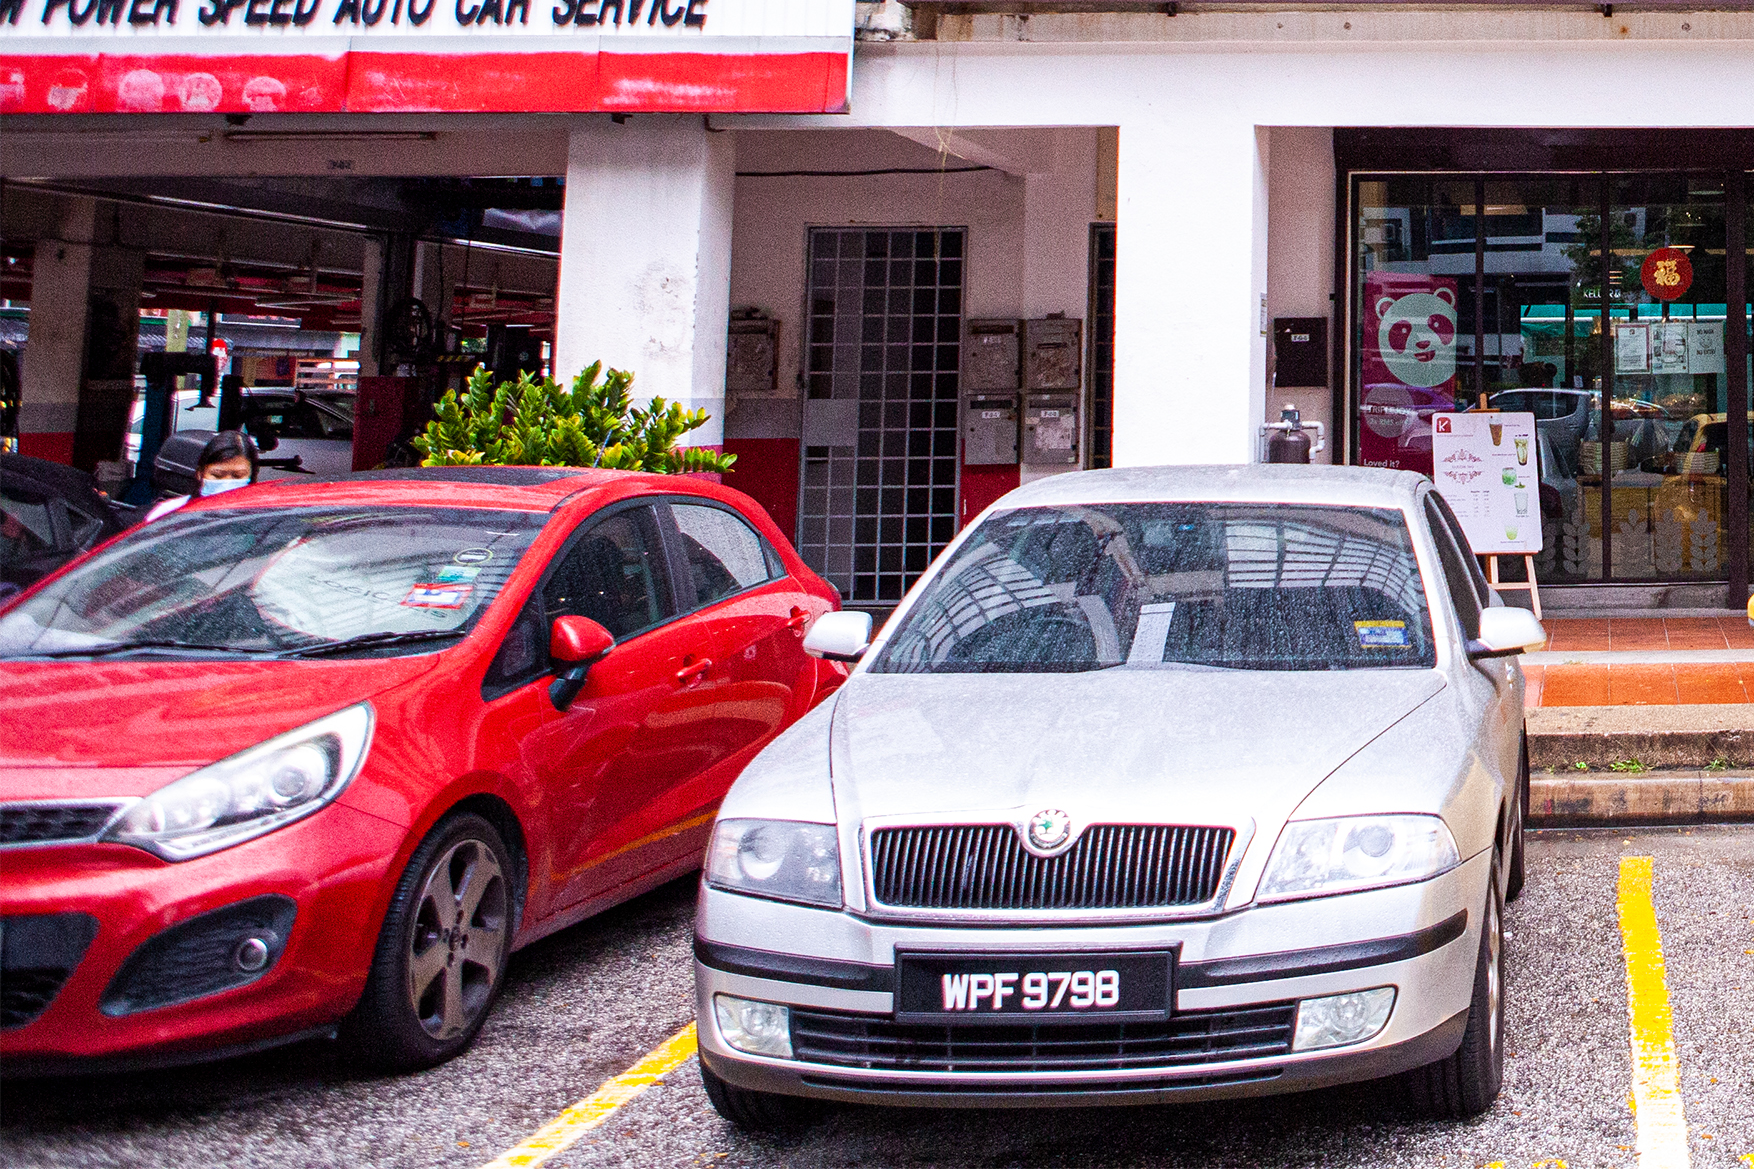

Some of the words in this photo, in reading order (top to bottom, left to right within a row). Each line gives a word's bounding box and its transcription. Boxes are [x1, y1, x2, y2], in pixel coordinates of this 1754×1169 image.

[1363, 458, 1388, 468] Loved
[1389, 459, 1400, 468] it?
[941, 972, 1019, 1010] WPF
[1021, 969, 1120, 1010] 9798
